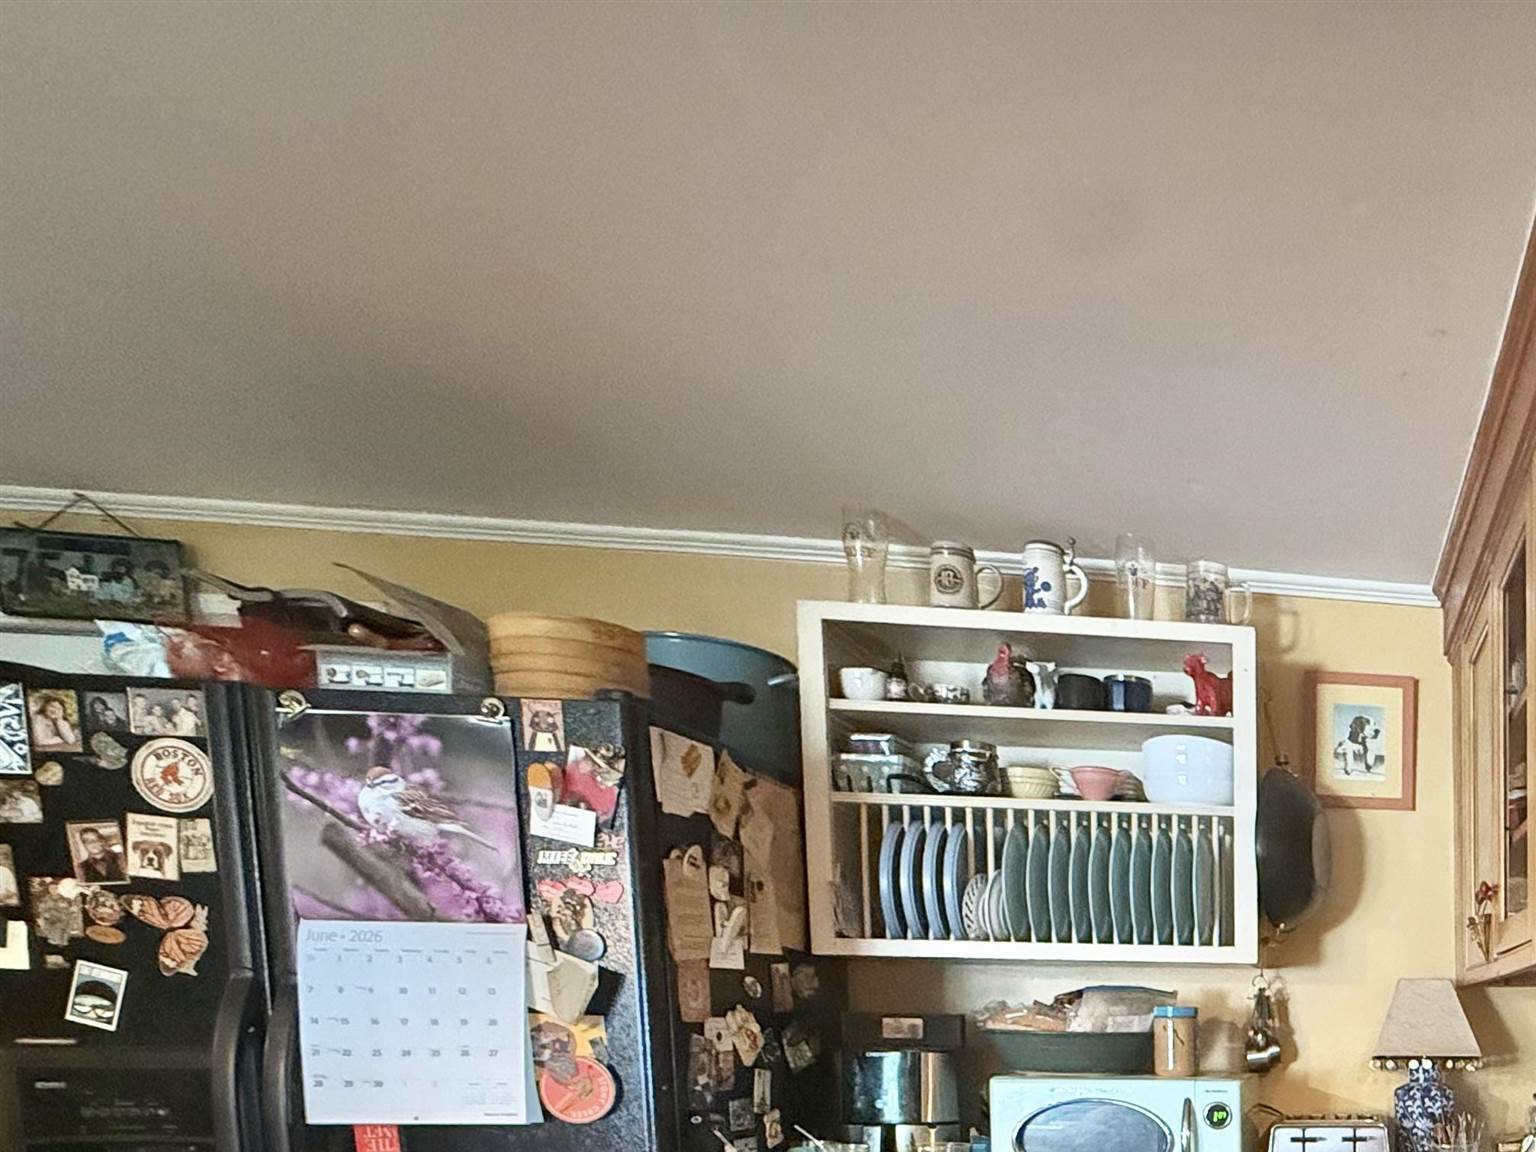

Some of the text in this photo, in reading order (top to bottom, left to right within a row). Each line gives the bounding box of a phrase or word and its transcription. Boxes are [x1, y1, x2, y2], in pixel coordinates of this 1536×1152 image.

[153, 748, 204, 777] BOSTON
[305, 930, 383, 943] June 2026
